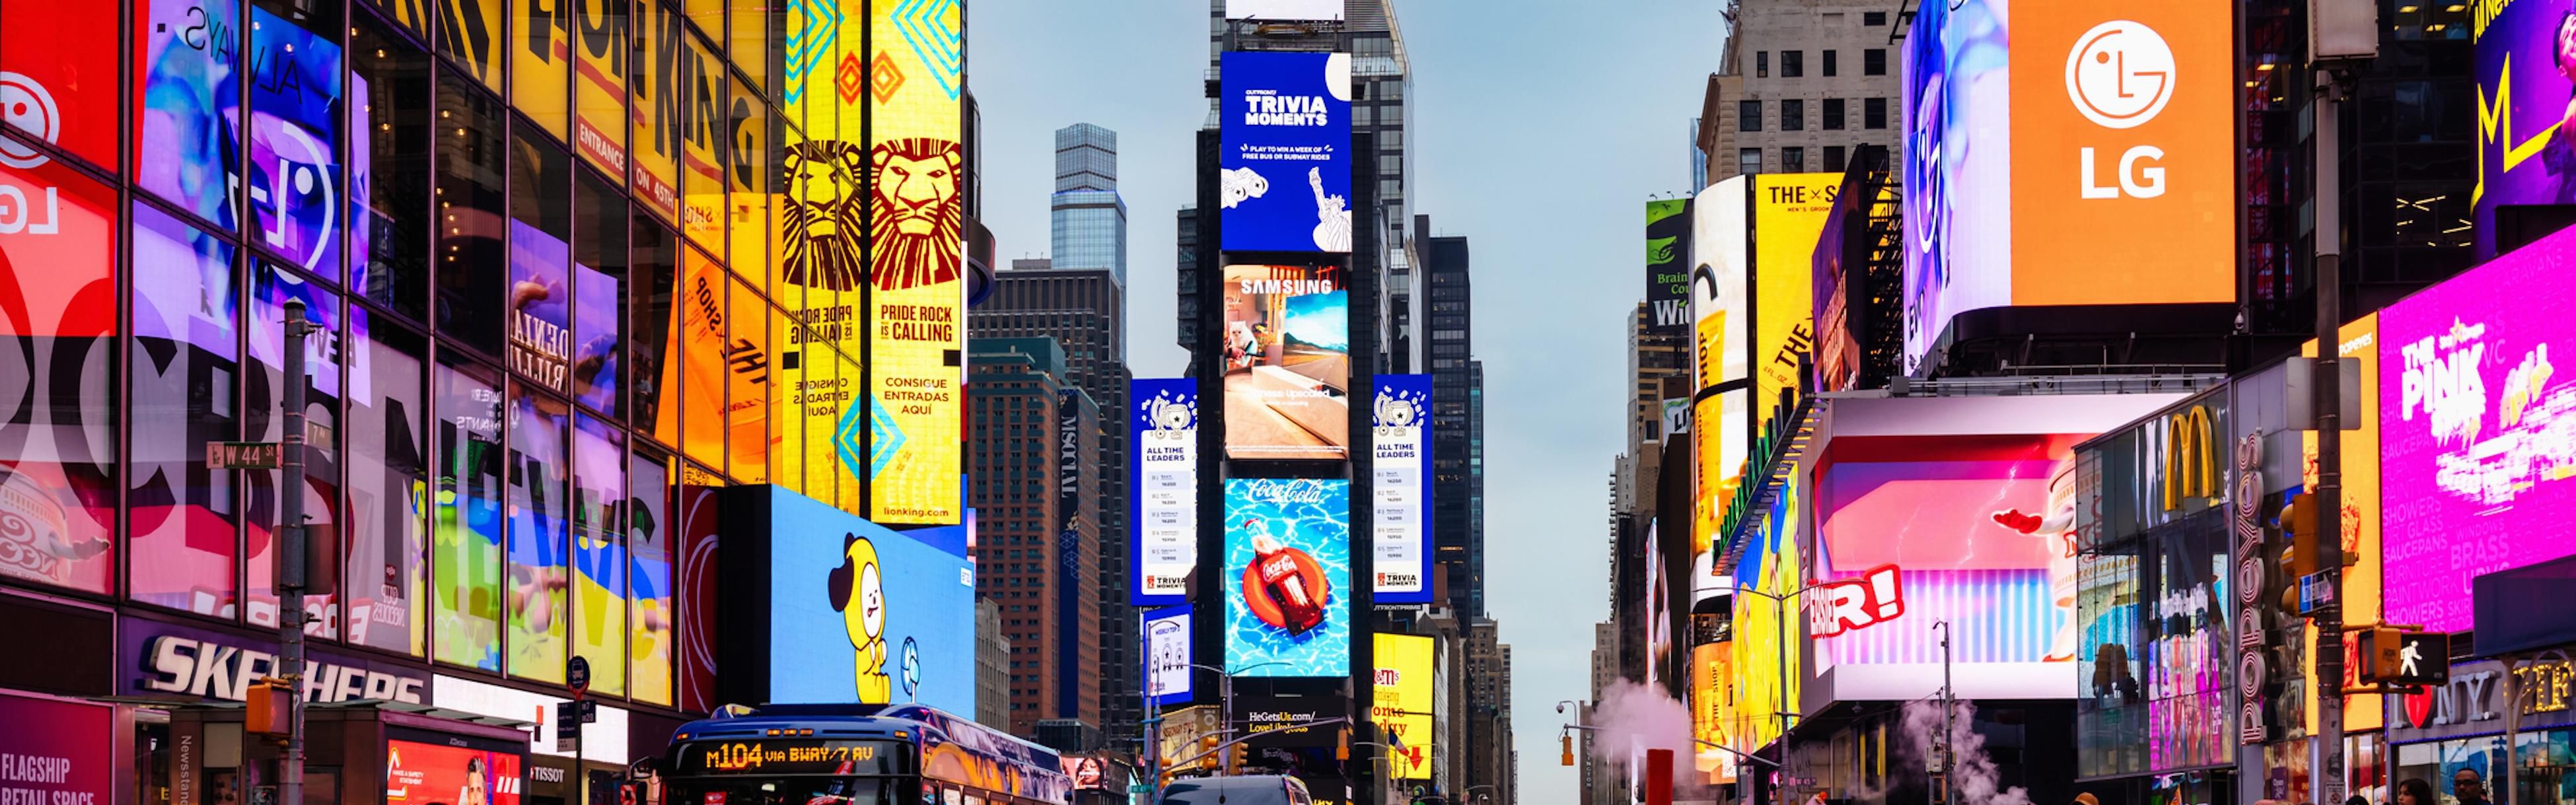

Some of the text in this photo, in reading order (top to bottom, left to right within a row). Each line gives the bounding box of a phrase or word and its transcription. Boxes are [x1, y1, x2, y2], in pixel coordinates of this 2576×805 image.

[1245, 96, 1328, 114] TRIVIA
[1245, 113, 1328, 127] MOMENTS
[579, 123, 674, 210] ENTRANCE ON 45TH
[2081, 145, 2165, 198] LG
[1768, 186, 1806, 203] THE
[1240, 279, 1332, 295] SAMSUNG
[880, 305, 952, 323] PRIDE ROCK
[880, 322, 952, 342] IS CALLING
[1774, 323, 1814, 368] THE
[2401, 335, 2435, 371] THE
[885, 378, 947, 388] CONSIGUE
[2401, 341, 2487, 421] PINK
[884, 390, 949, 402] ENTRADAS
[901, 403, 931, 415] AQUÍ
[225, 444, 274, 466] W 44 St
[883, 507, 949, 518] lionking.com
[2451, 532, 2509, 571] BRASS
[146, 635, 423, 705] SKEHERS
[705, 743, 763, 769] M104
[765, 751, 786, 762] VIA
[852, 746, 873, 760] AV
[1, 753, 71, 785] FLAGSHIP
[534, 766, 565, 783] TISSOT
